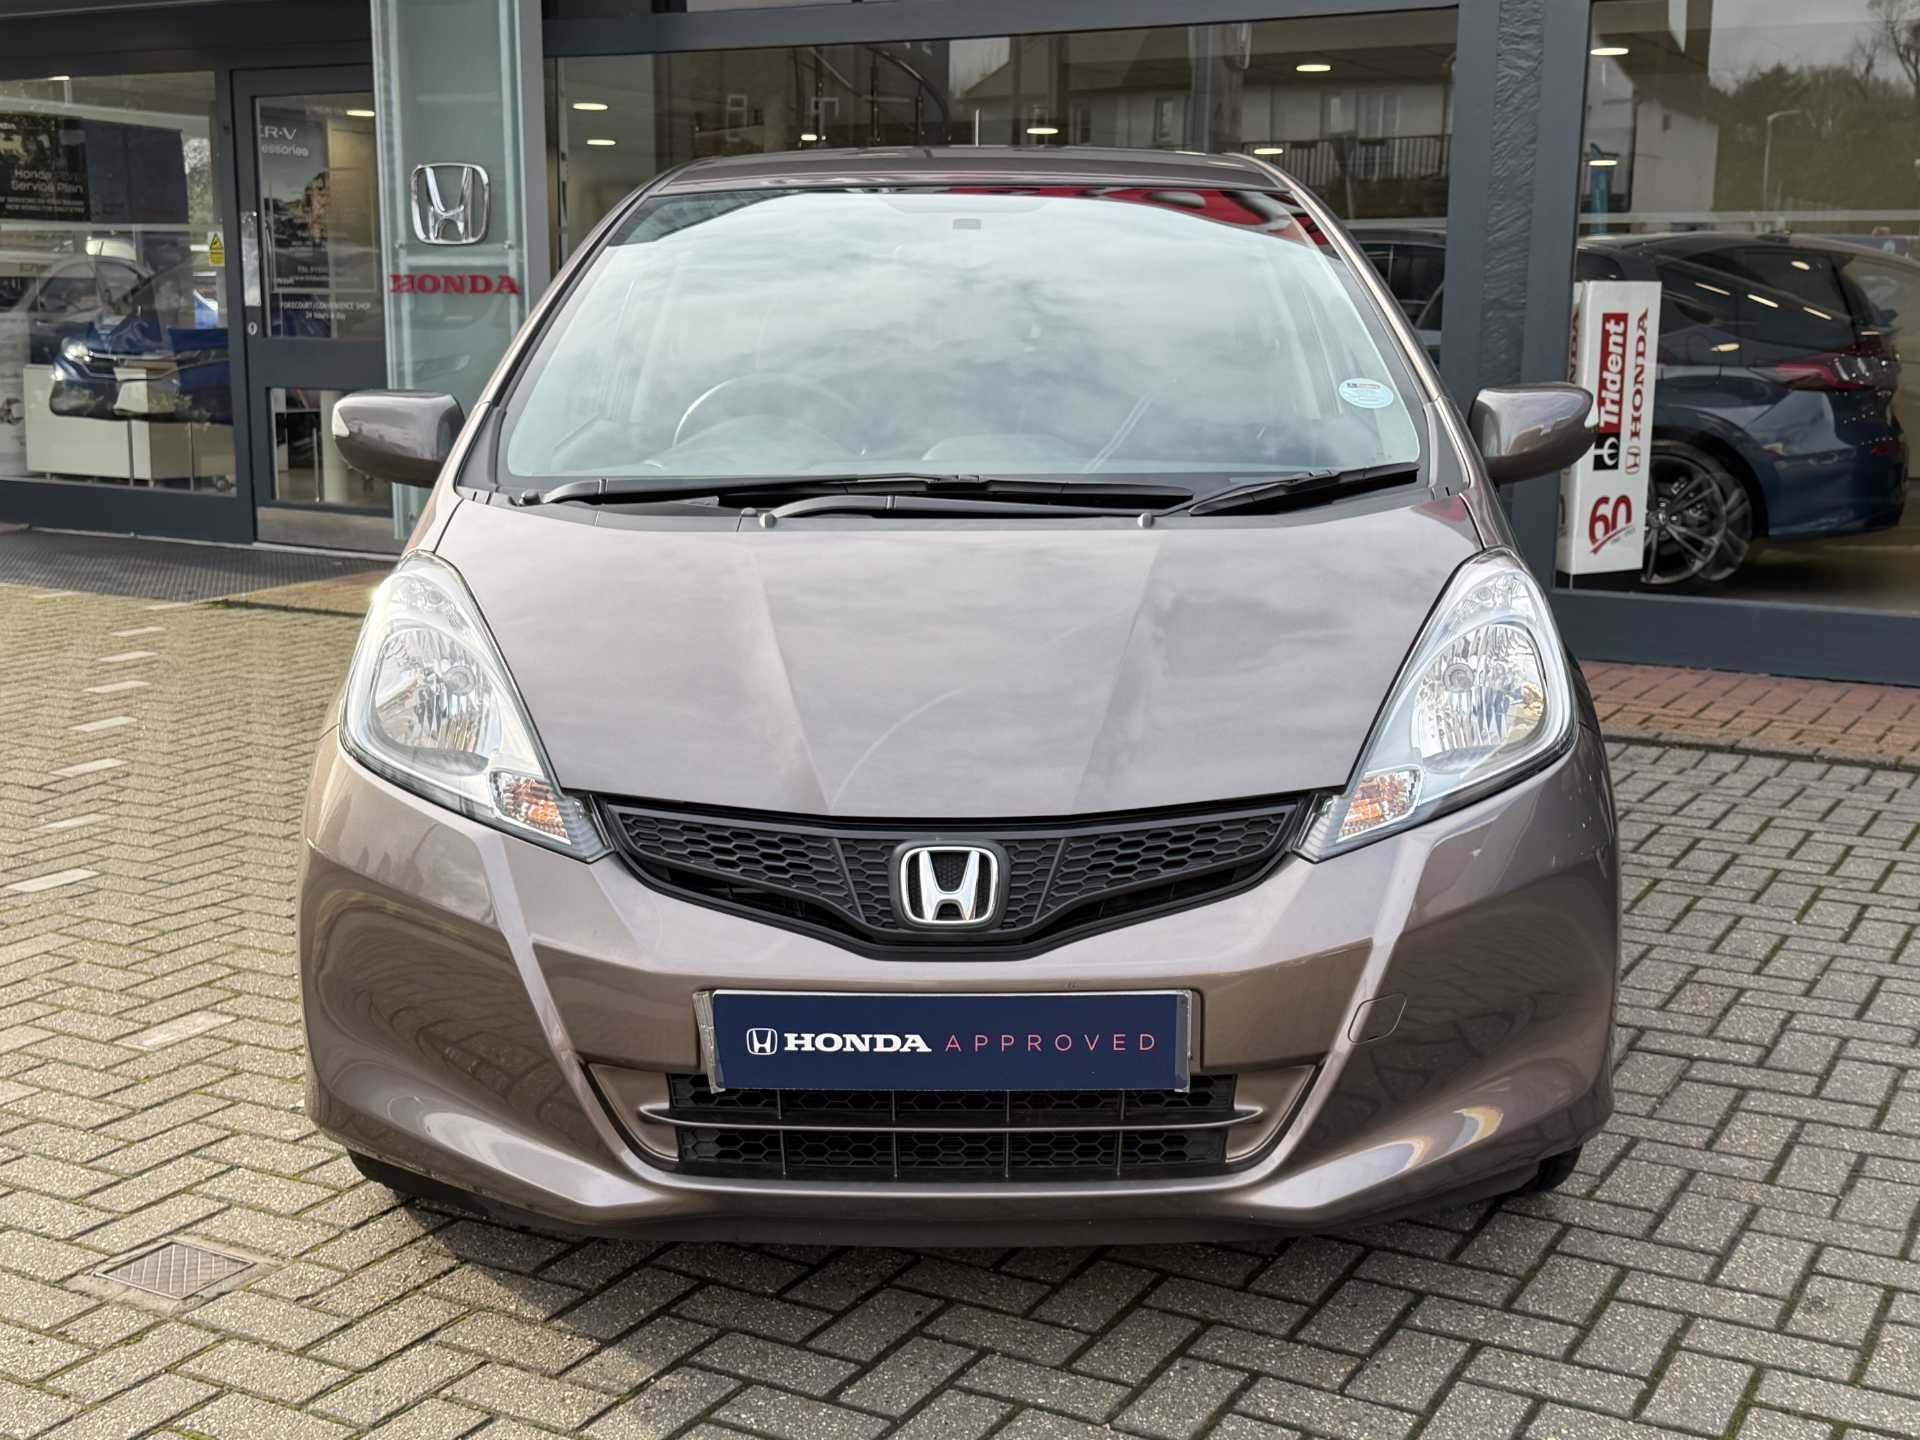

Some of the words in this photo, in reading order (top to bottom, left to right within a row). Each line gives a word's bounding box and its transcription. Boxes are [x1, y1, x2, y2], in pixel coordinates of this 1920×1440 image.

[390, 272, 520, 295] HONDA
[1599, 319, 1625, 428] Trident
[1629, 306, 1649, 441] HONDA
[1588, 493, 1633, 547] 60
[784, 1033, 932, 1052] HONDA
[945, 1033, 1155, 1052] APPROVED
